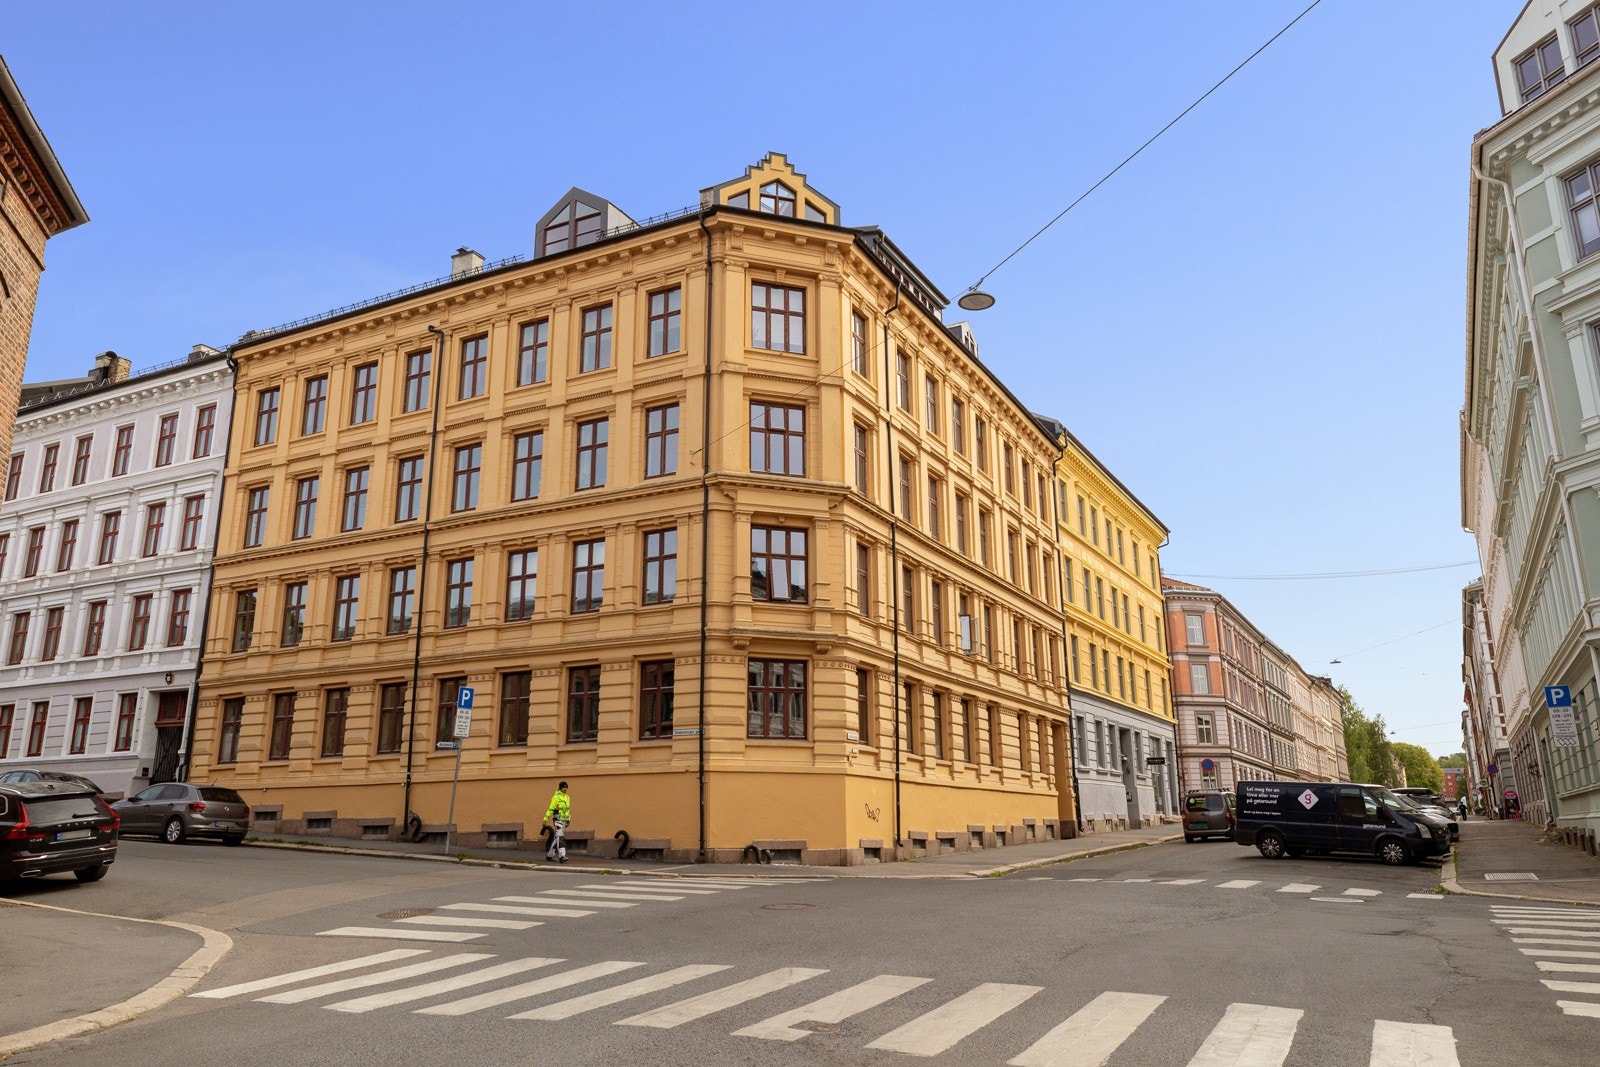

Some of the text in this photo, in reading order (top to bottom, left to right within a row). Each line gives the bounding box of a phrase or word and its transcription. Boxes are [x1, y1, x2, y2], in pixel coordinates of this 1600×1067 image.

[461, 690, 470, 705] P
[1550, 688, 1565, 705] P
[1304, 793, 1312, 805] g
